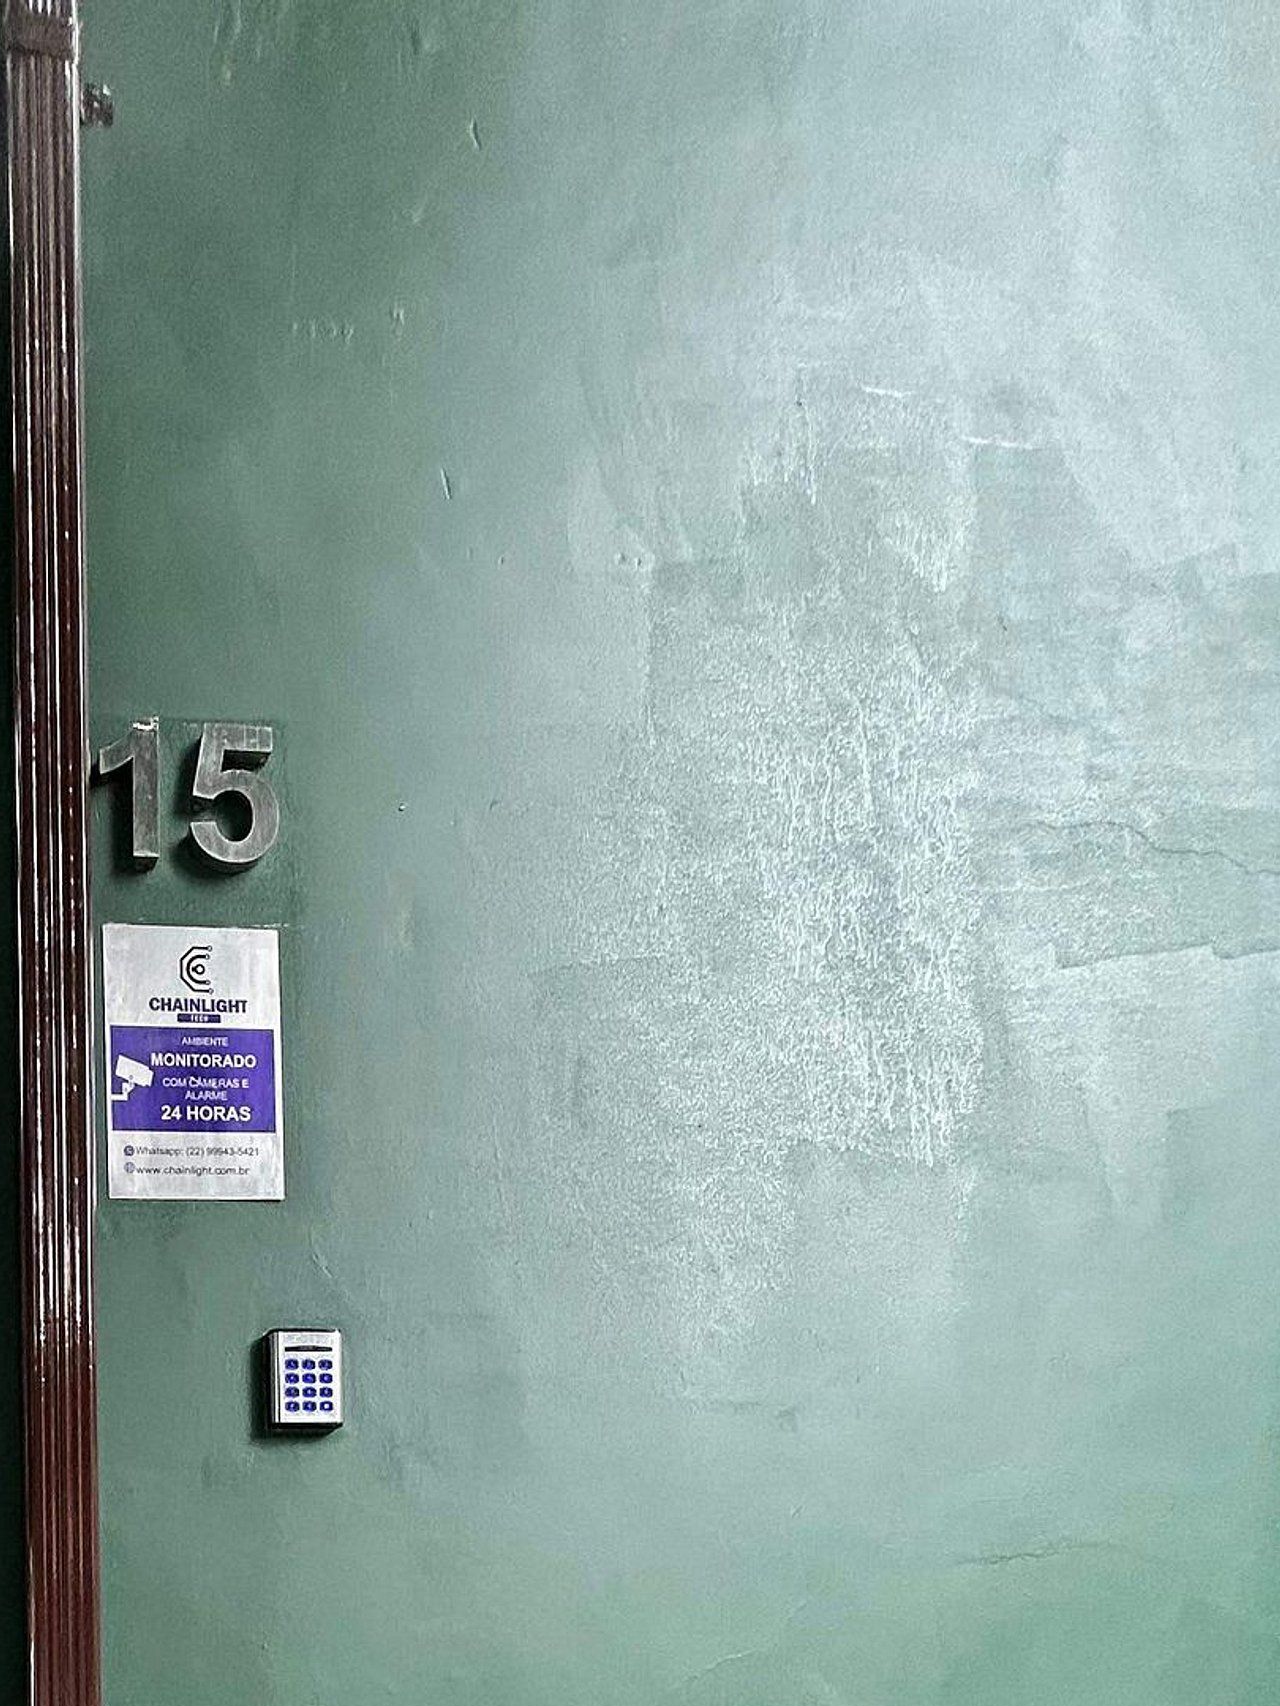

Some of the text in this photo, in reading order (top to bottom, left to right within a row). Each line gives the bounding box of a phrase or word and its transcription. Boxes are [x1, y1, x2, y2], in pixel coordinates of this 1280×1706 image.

[99, 716, 279, 863] 15
[149, 997, 247, 1013] CHAINLIGHT
[181, 1036, 228, 1047] AMBIENTE
[151, 1053, 257, 1068] MONITORADO
[162, 1076, 249, 1088] COM CÂMERAS E
[185, 1090, 227, 1101] ALARME
[161, 1105, 251, 1121] 24 HORAS
[136, 1165, 250, 1176] www.chainlight.com.br
